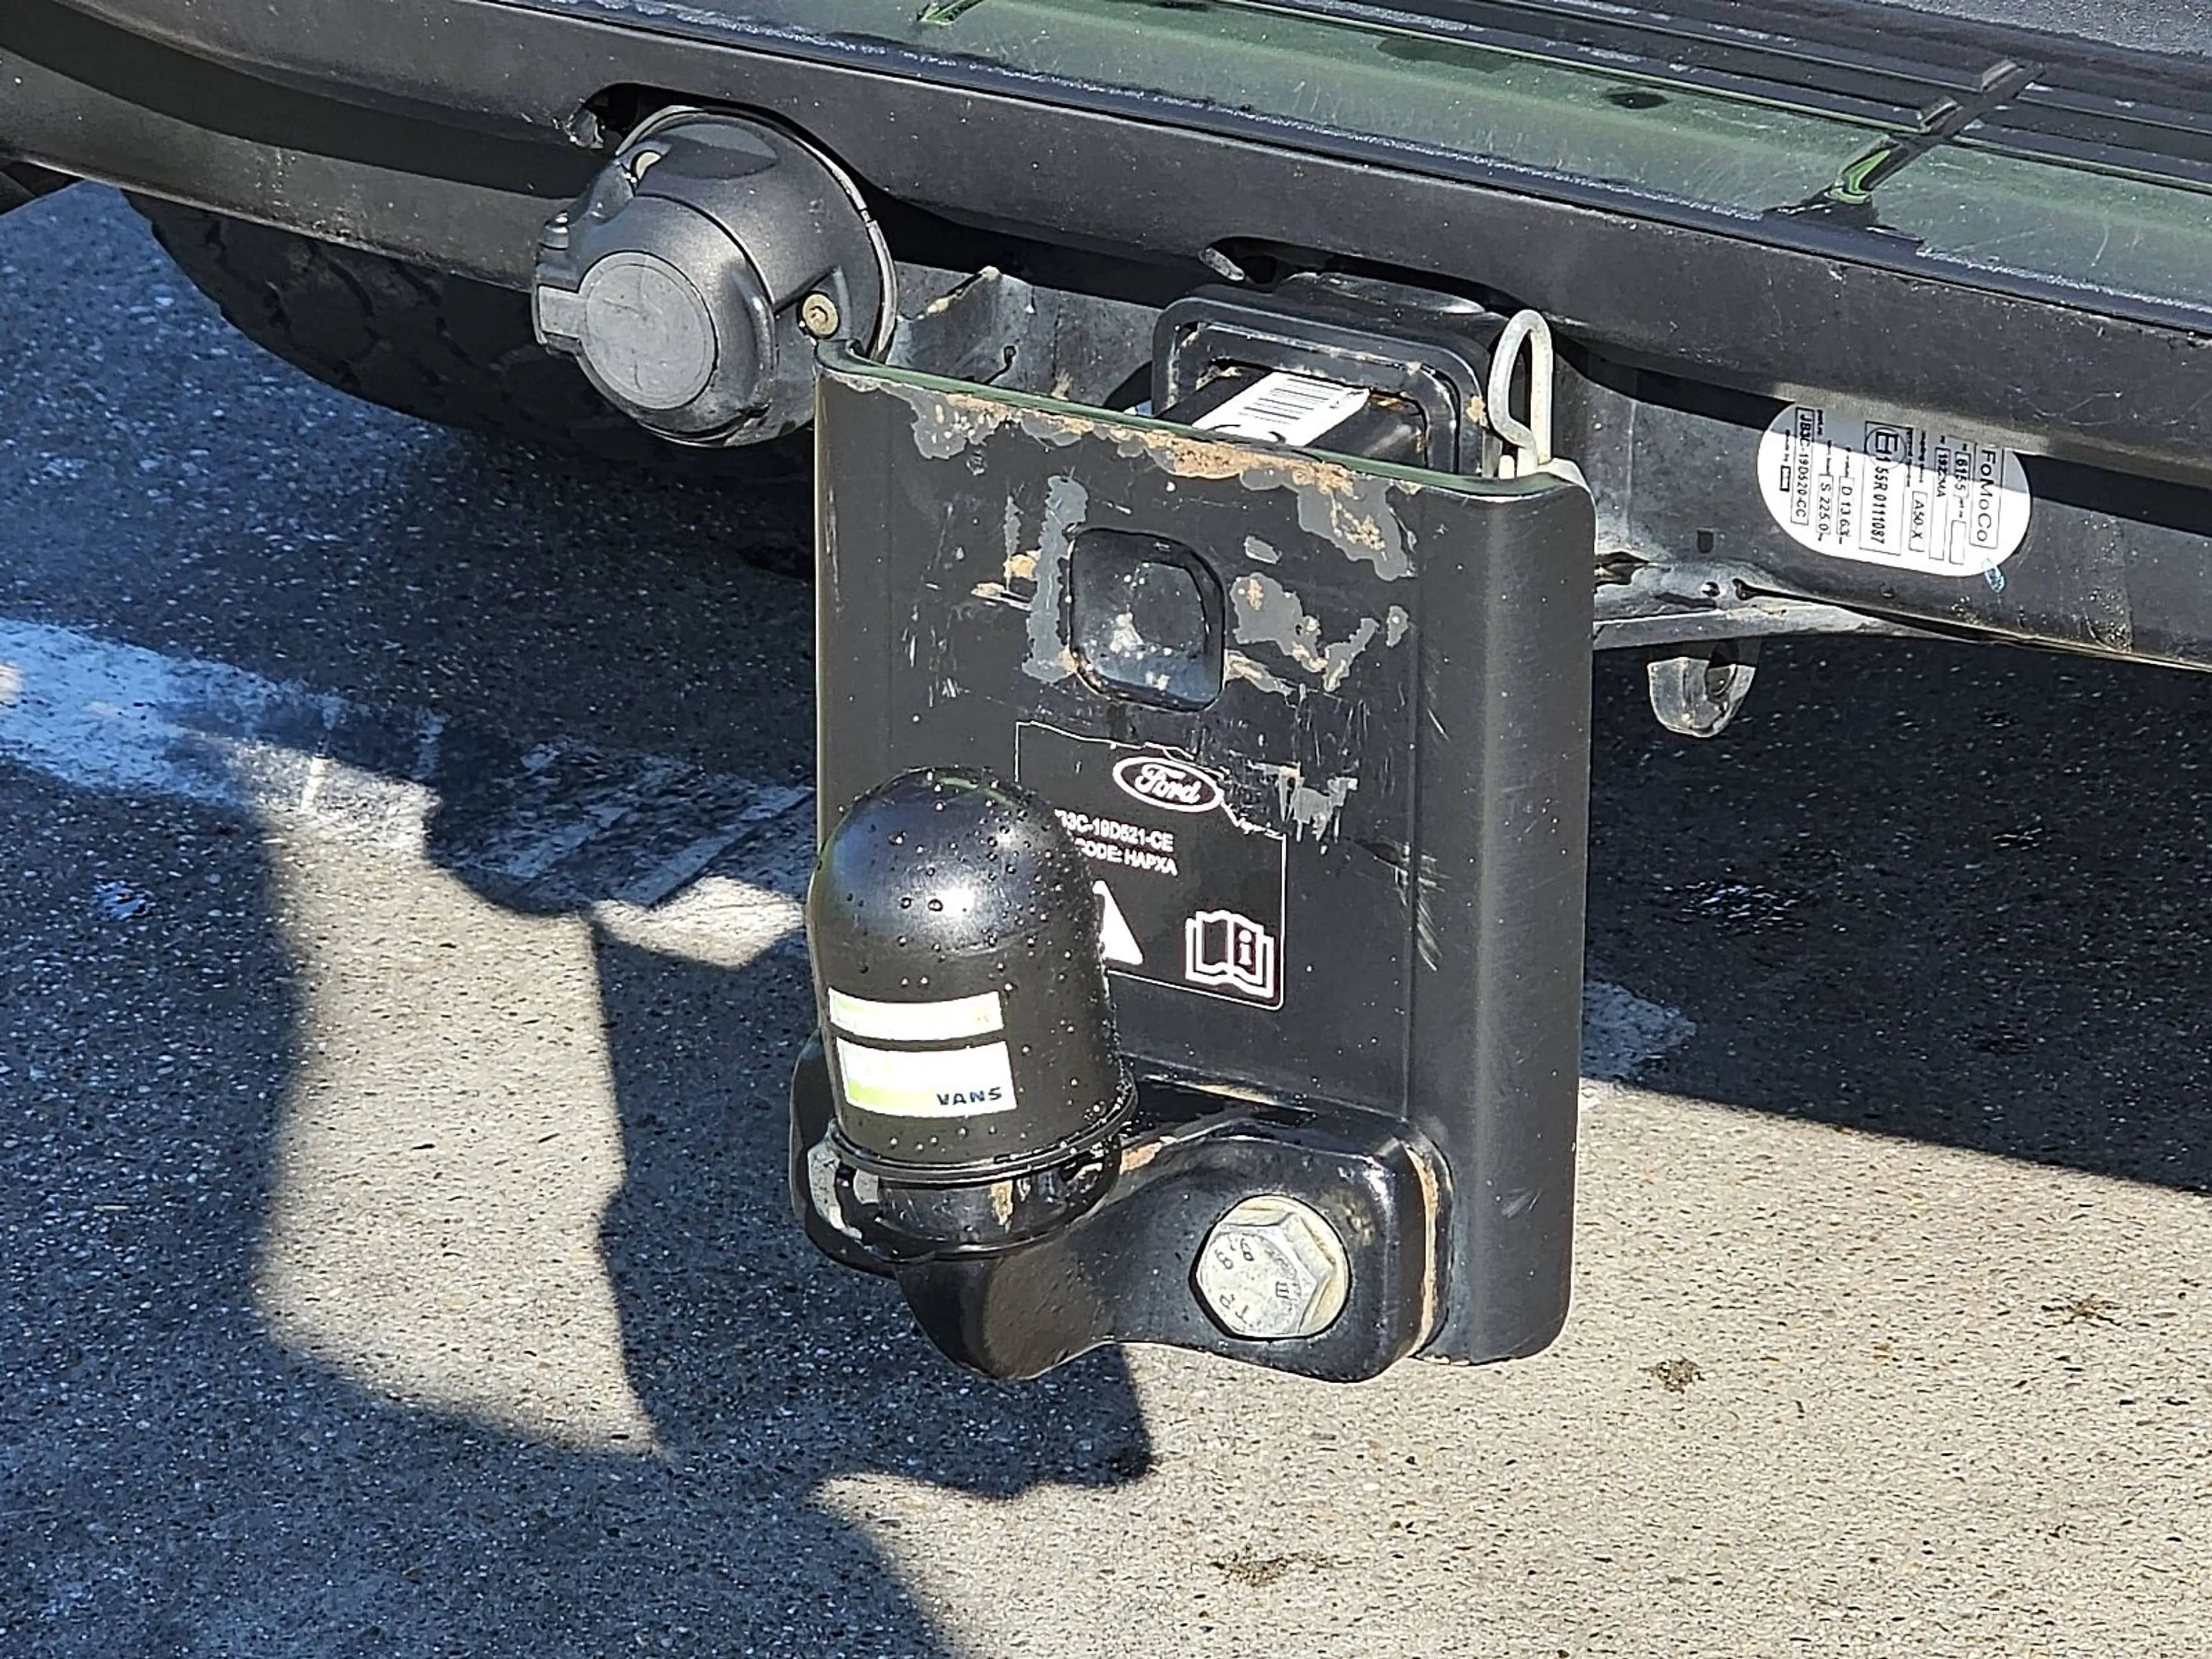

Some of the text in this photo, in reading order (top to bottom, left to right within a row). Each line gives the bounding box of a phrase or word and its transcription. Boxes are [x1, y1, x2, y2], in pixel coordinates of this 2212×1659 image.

[1820, 482, 1831, 492] S
[1873, 466, 1888, 491] 55R
[1976, 449, 1997, 542] FoMoCo
[1871, 494, 1885, 544] 0111087
[1911, 499, 1924, 540] A50-X
[1134, 762, 1203, 804] Ford
[936, 1086, 1002, 1106] VANS
